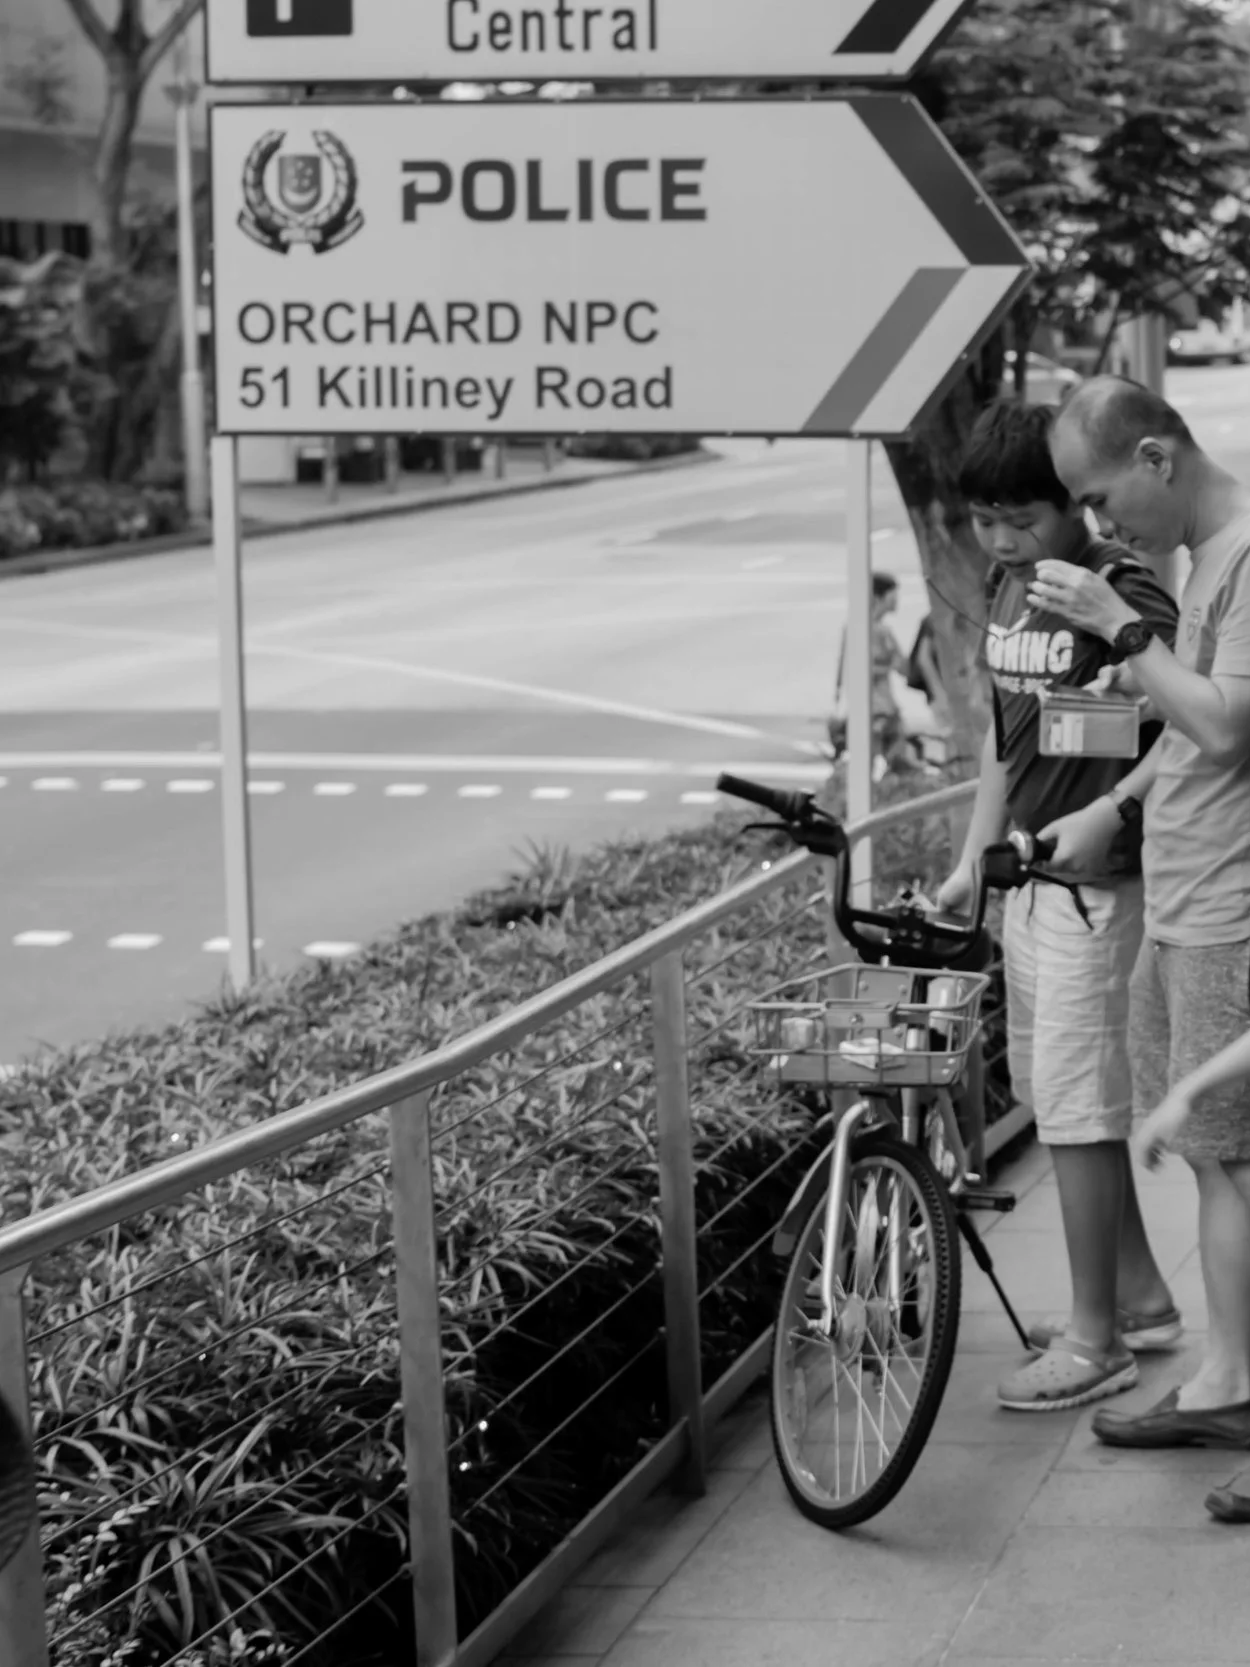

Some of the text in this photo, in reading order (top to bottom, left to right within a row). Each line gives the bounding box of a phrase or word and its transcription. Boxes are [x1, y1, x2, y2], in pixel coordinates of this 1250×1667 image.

[446, 0, 658, 54] Central
[401, 157, 708, 223] POLICE
[237, 299, 659, 345] ORCHARD NPC
[239, 365, 673, 422] 51 Killiney Road
